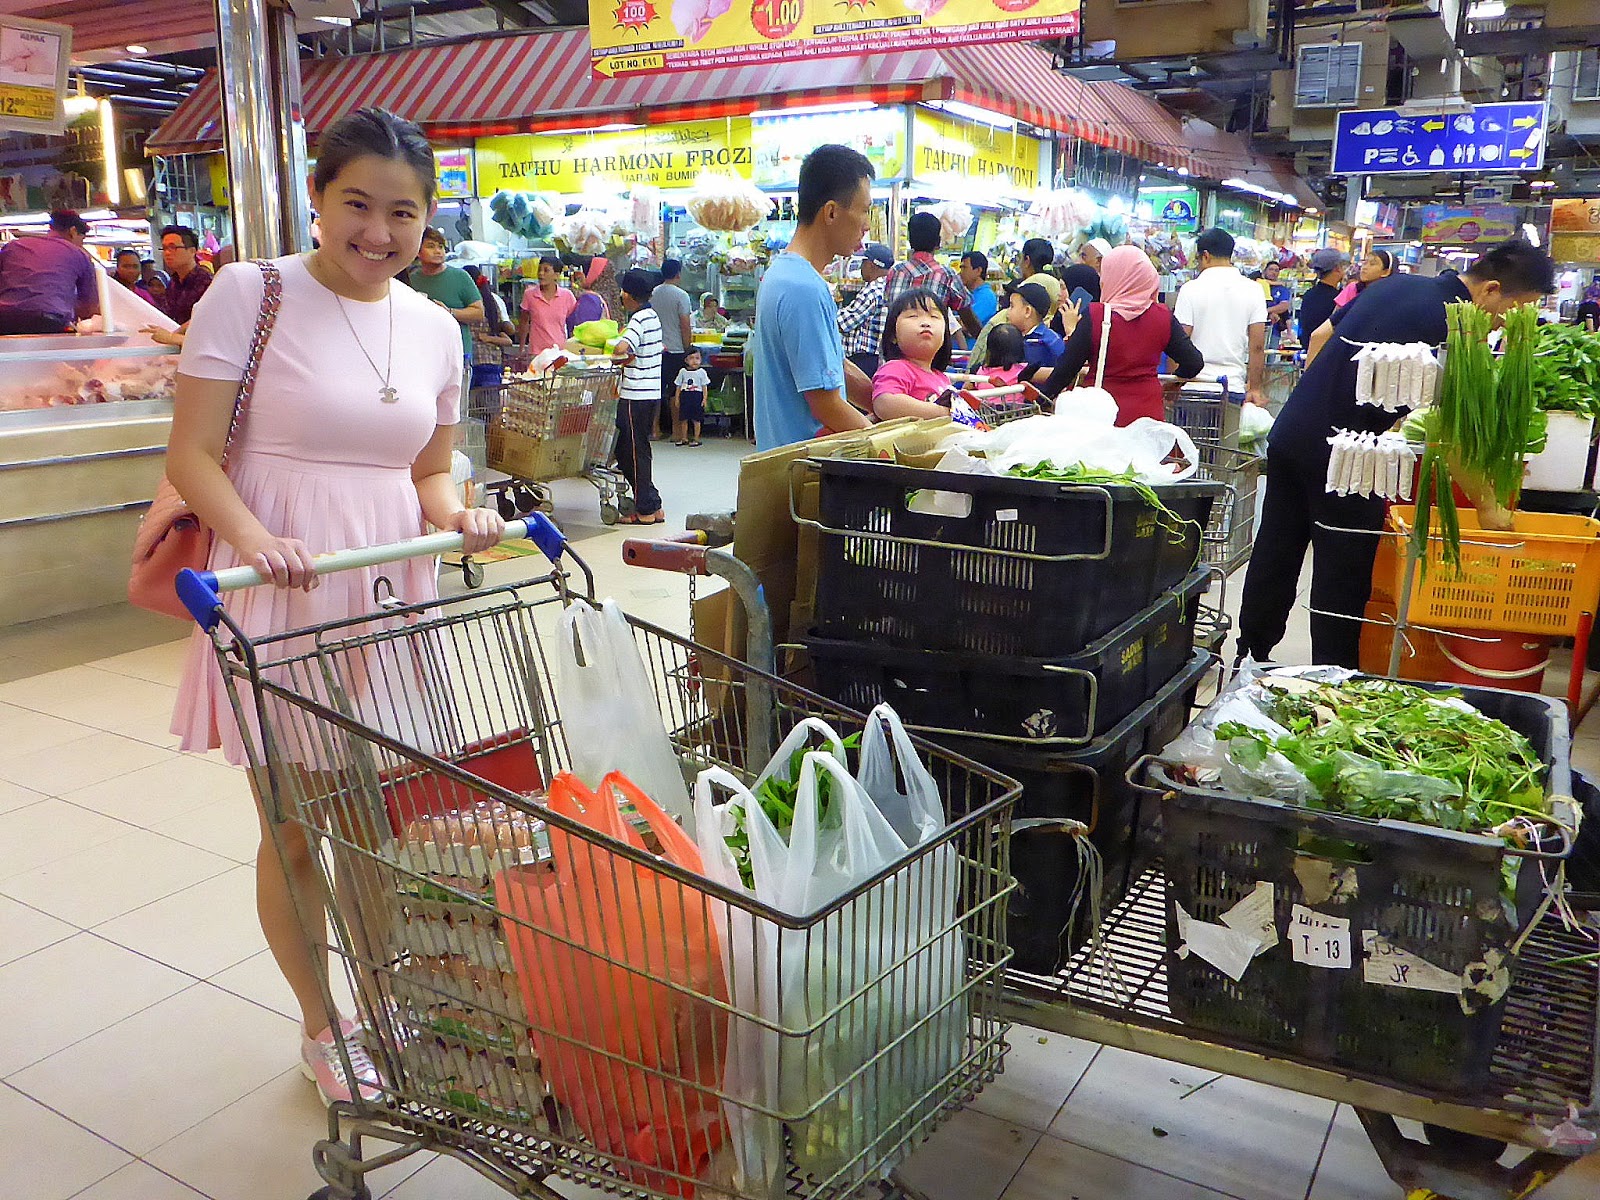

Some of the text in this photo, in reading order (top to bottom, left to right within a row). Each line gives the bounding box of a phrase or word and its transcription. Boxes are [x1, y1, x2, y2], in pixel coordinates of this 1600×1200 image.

[623, 5, 645, 18] 100
[765, 0, 799, 27] 1.00
[609, 61, 624, 69] LOT
[499, 159, 561, 178] TAUHU
[573, 152, 673, 174] HARMONI
[1325, 940, 1340, 959] 13
